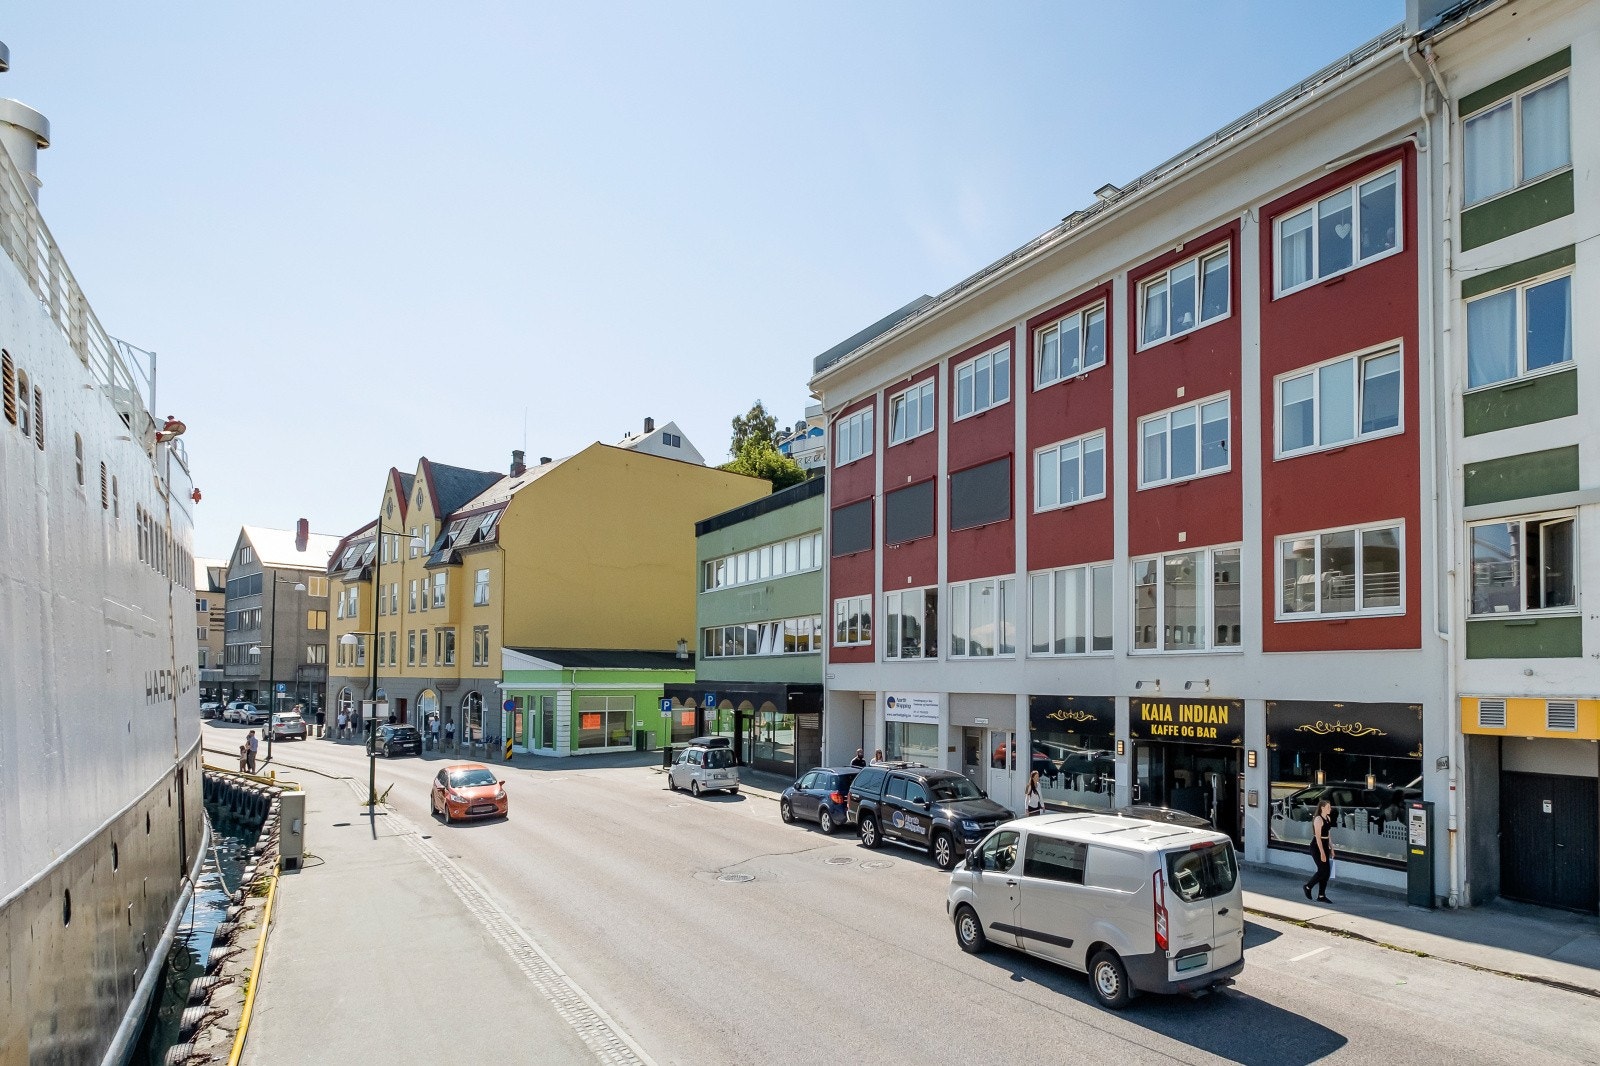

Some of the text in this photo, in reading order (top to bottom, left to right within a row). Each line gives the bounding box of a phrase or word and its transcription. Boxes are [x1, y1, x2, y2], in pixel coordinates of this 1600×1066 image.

[663, 701, 670, 710] P
[707, 696, 713, 705] P
[1141, 703, 1229, 724] KAIA INDIAN
[1151, 724, 1217, 739] KAFFE OG BAR
[905, 814, 920, 825] North
[904, 821, 926, 835] Shipping
